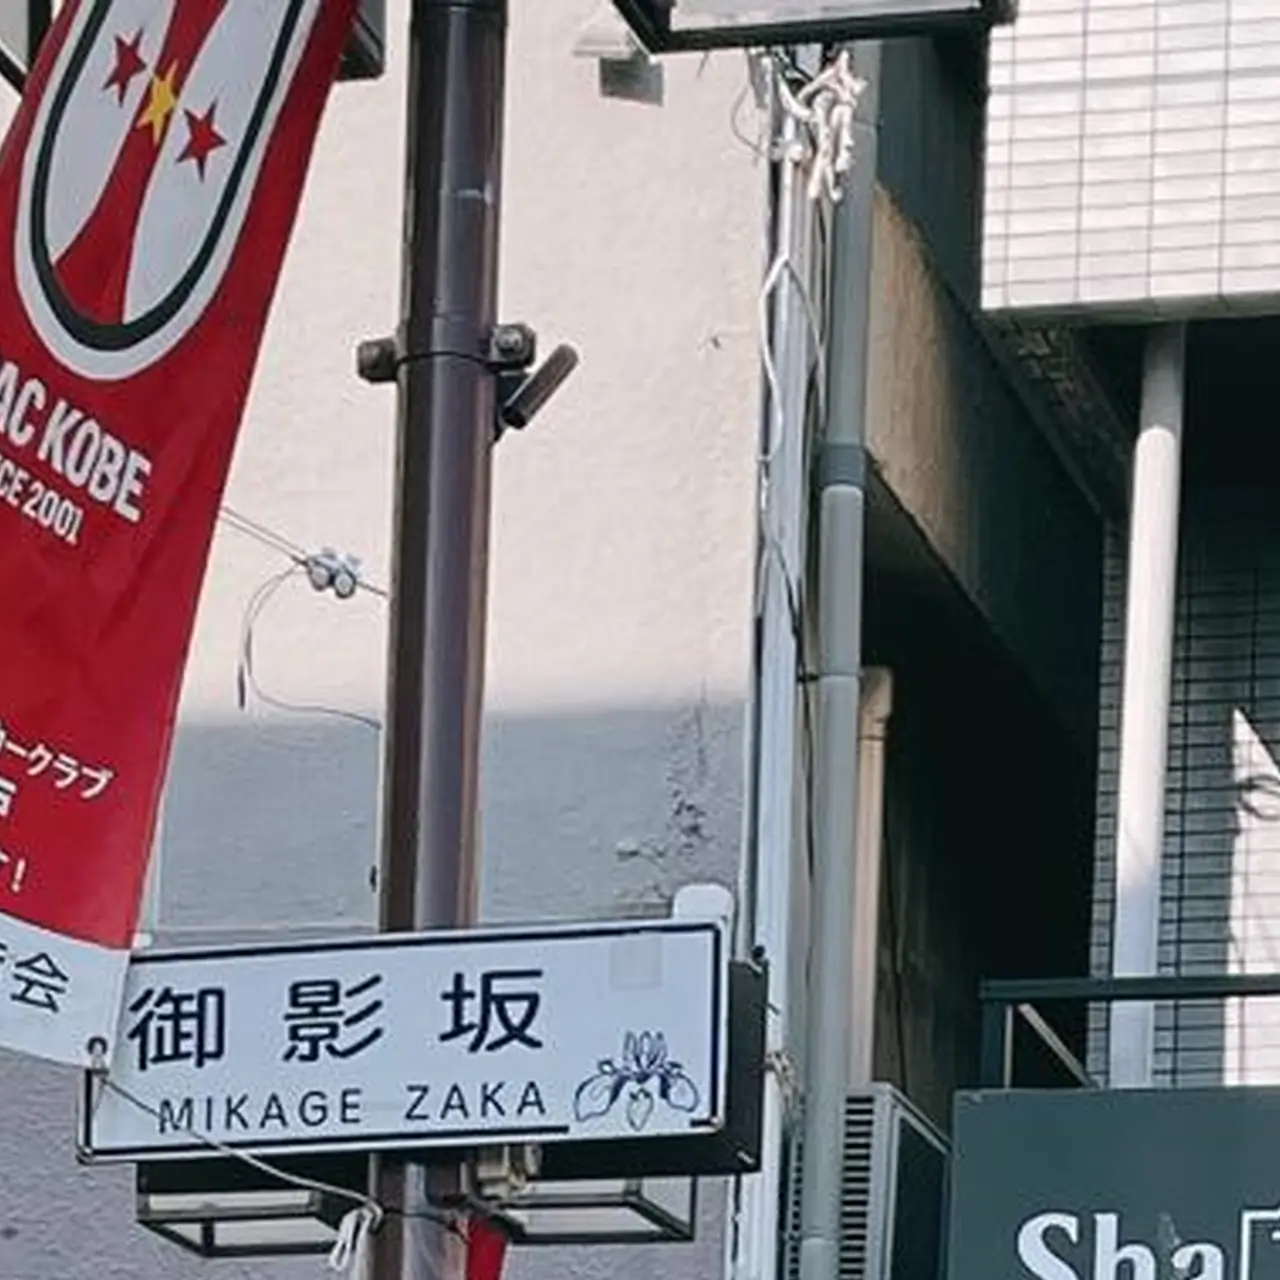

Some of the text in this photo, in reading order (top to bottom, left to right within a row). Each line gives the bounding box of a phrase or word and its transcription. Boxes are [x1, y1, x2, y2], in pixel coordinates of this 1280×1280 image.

[38, 406, 152, 524] KOBE
[23, 477, 86, 545] 2001
[127, 968, 545, 1070] 御影坂
[158, 1080, 548, 1135] MIKAGE ZAKA
